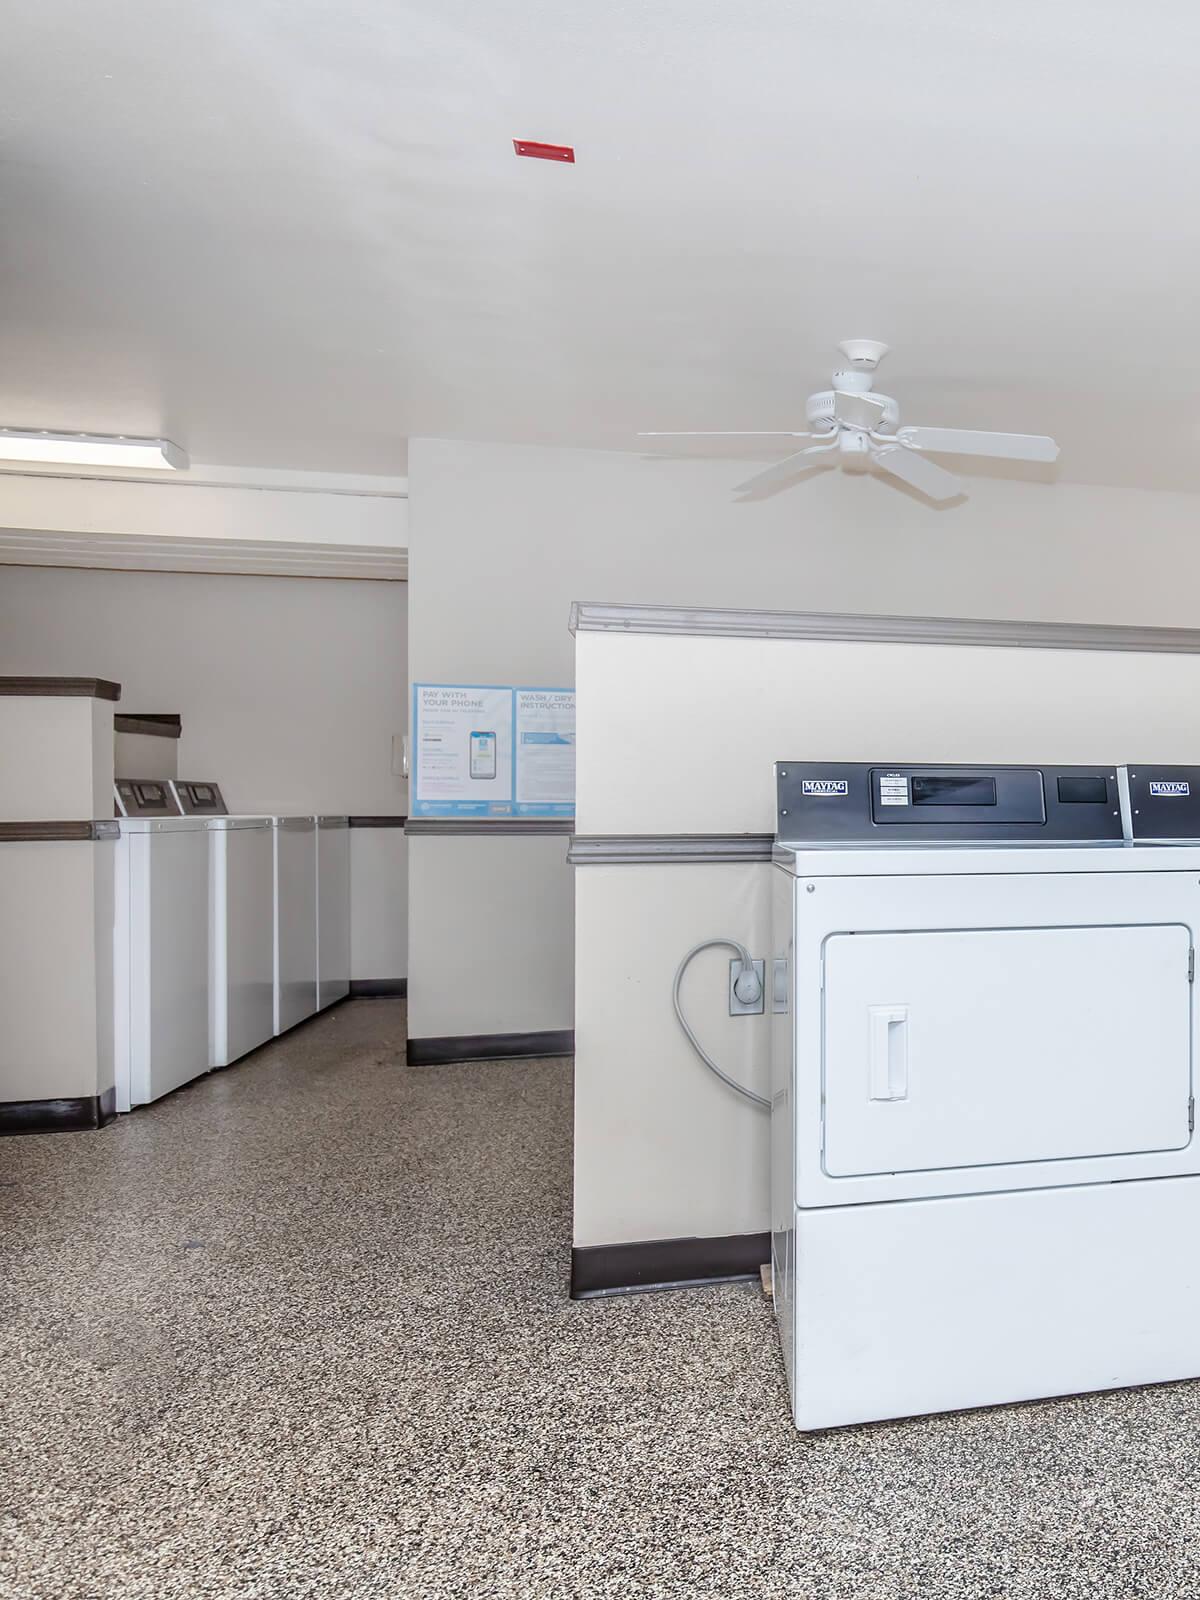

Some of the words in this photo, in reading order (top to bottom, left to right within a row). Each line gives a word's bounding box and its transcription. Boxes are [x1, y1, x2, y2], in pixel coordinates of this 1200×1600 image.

[423, 690, 439, 698] PAY
[442, 691, 467, 699] WITH
[520, 694, 547, 702] WASH
[423, 699, 448, 707] YOUR
[451, 700, 484, 708] PHONE
[805, 782, 845, 790] MAYTAG
[1152, 783, 1187, 791] MAYTAG
